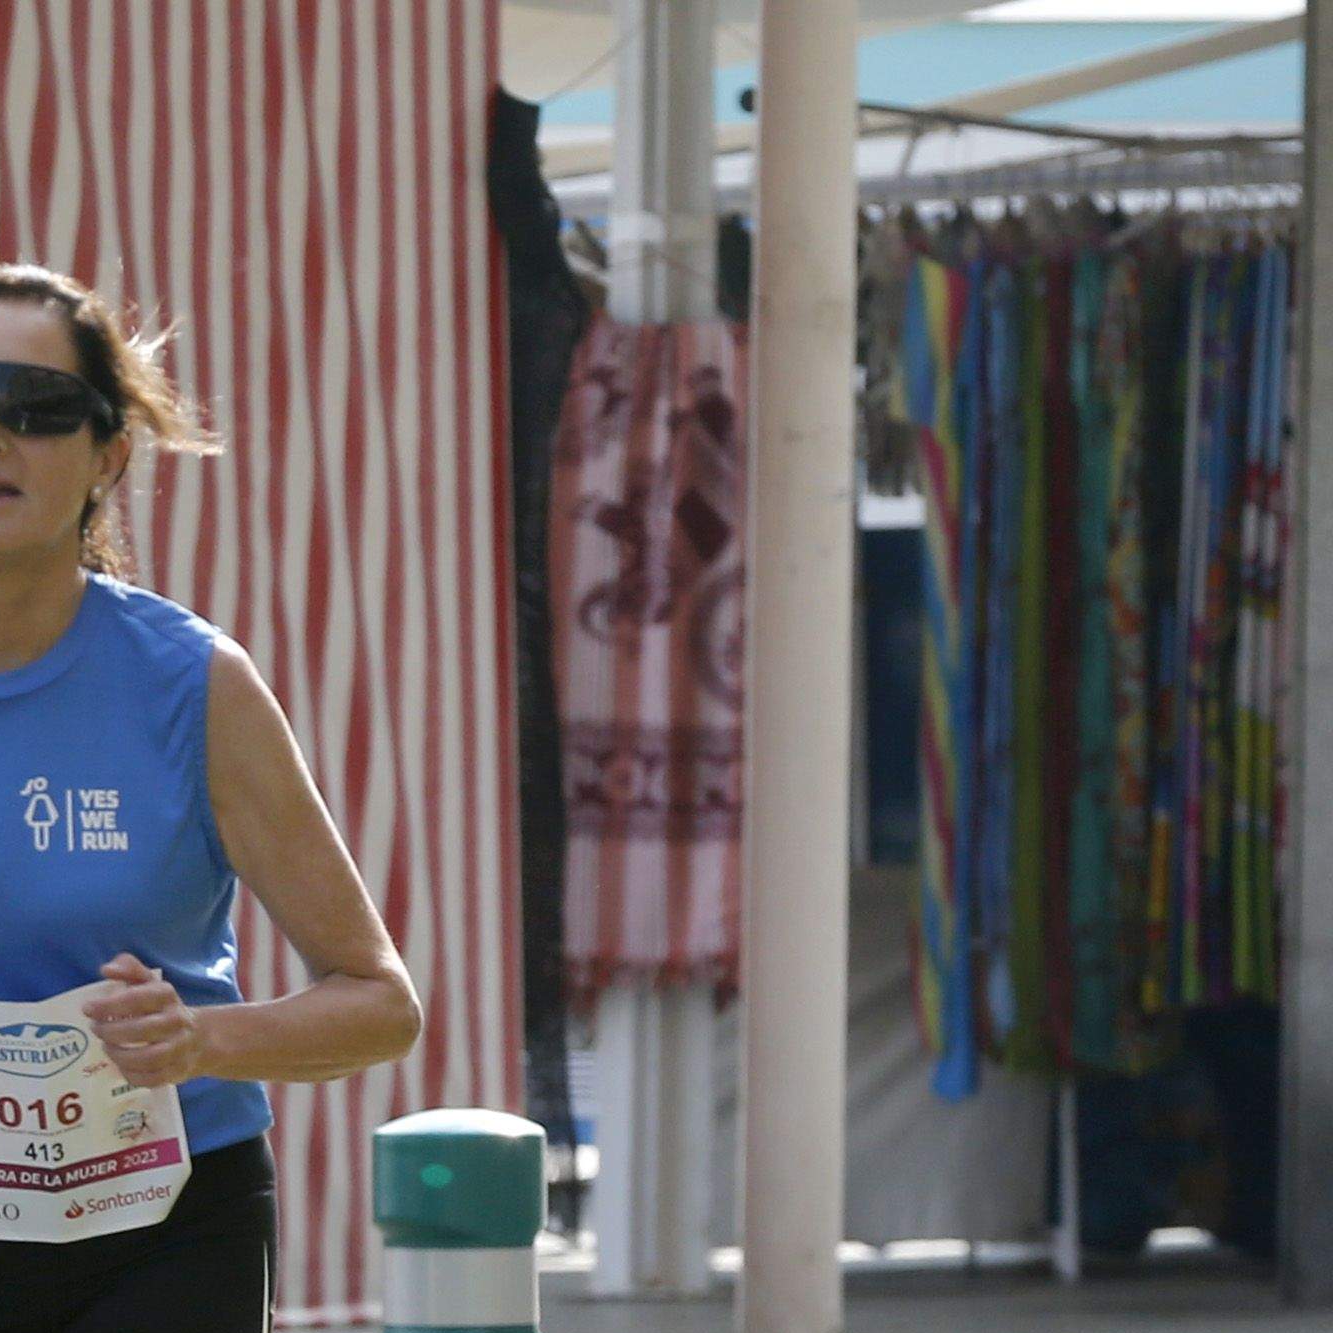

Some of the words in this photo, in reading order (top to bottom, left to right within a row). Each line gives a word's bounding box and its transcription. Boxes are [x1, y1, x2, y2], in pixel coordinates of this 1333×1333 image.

[79, 789, 119, 809] YES
[79, 811, 117, 830] WE
[82, 831, 129, 850] RUN
[24, 1141, 65, 1162] 413
[19, 1172, 41, 1186] DE
[43, 1174, 63, 1187] LA
[64, 1161, 118, 1185] MUJER
[123, 1148, 159, 1168] 2023
[87, 1183, 172, 1215] Santander
